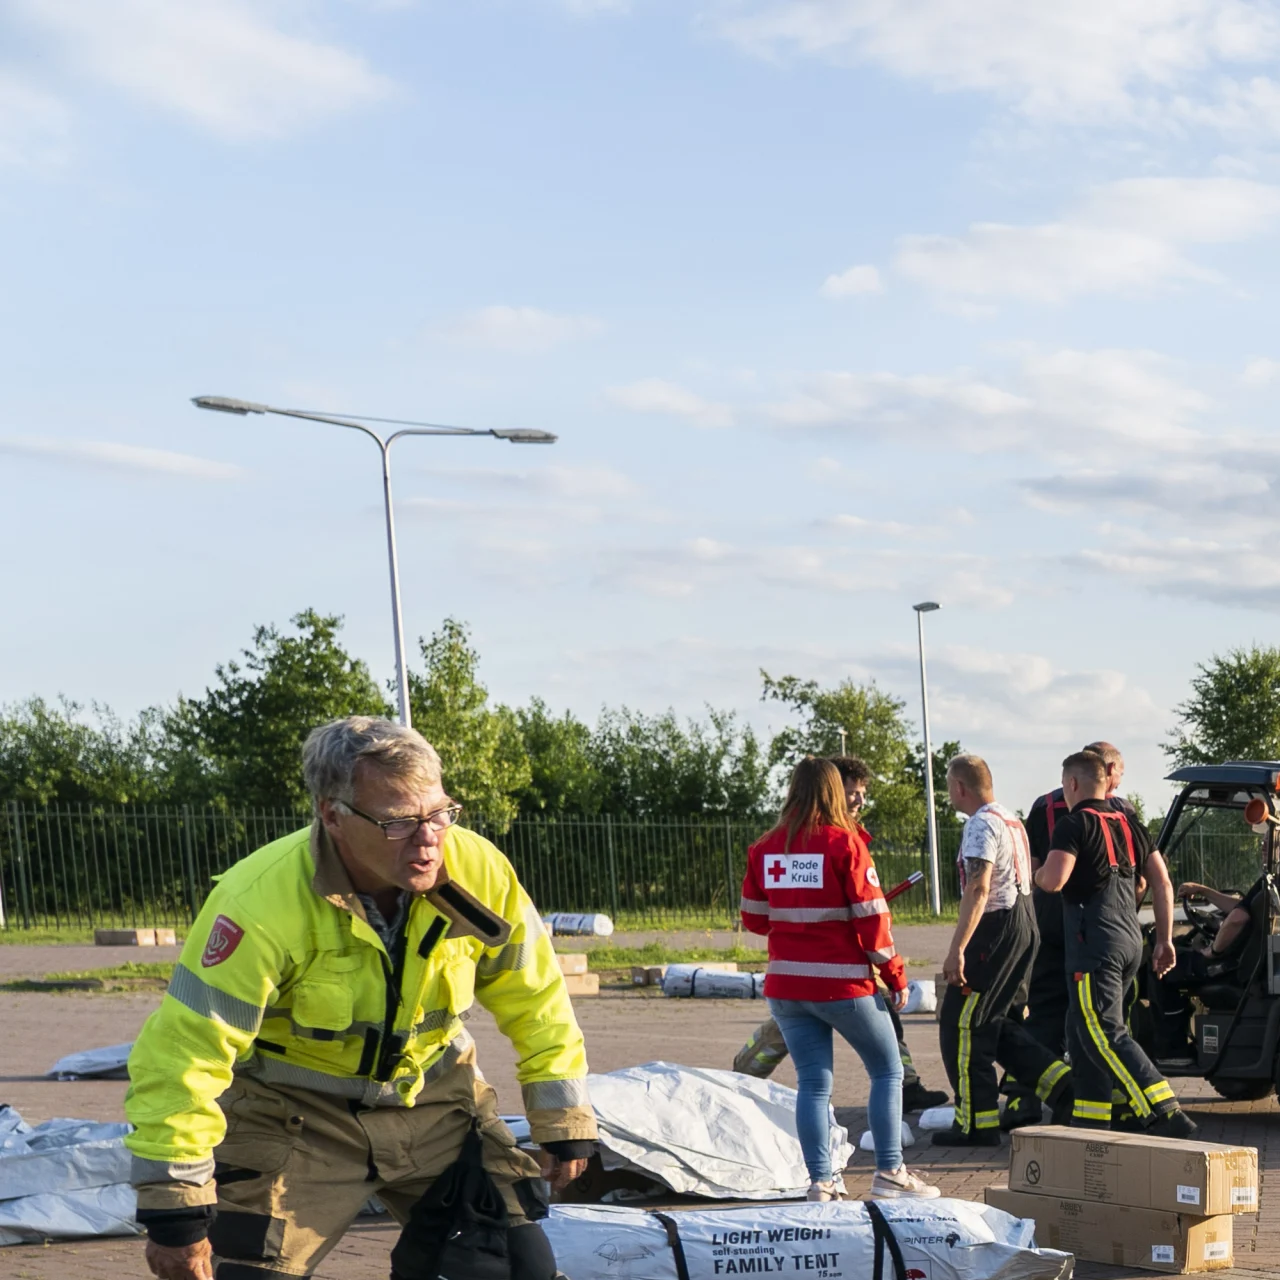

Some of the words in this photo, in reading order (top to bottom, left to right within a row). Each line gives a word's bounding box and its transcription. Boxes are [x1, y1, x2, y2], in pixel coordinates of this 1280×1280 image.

[792, 860, 819, 870] Rode
[791, 872, 819, 883] Kruis
[712, 1230, 763, 1246] LIGHT
[712, 1246, 775, 1256] self-standing
[714, 1256, 785, 1275] FAMILY
[791, 1252, 840, 1271] TENT
[818, 1270, 828, 1278] 15
